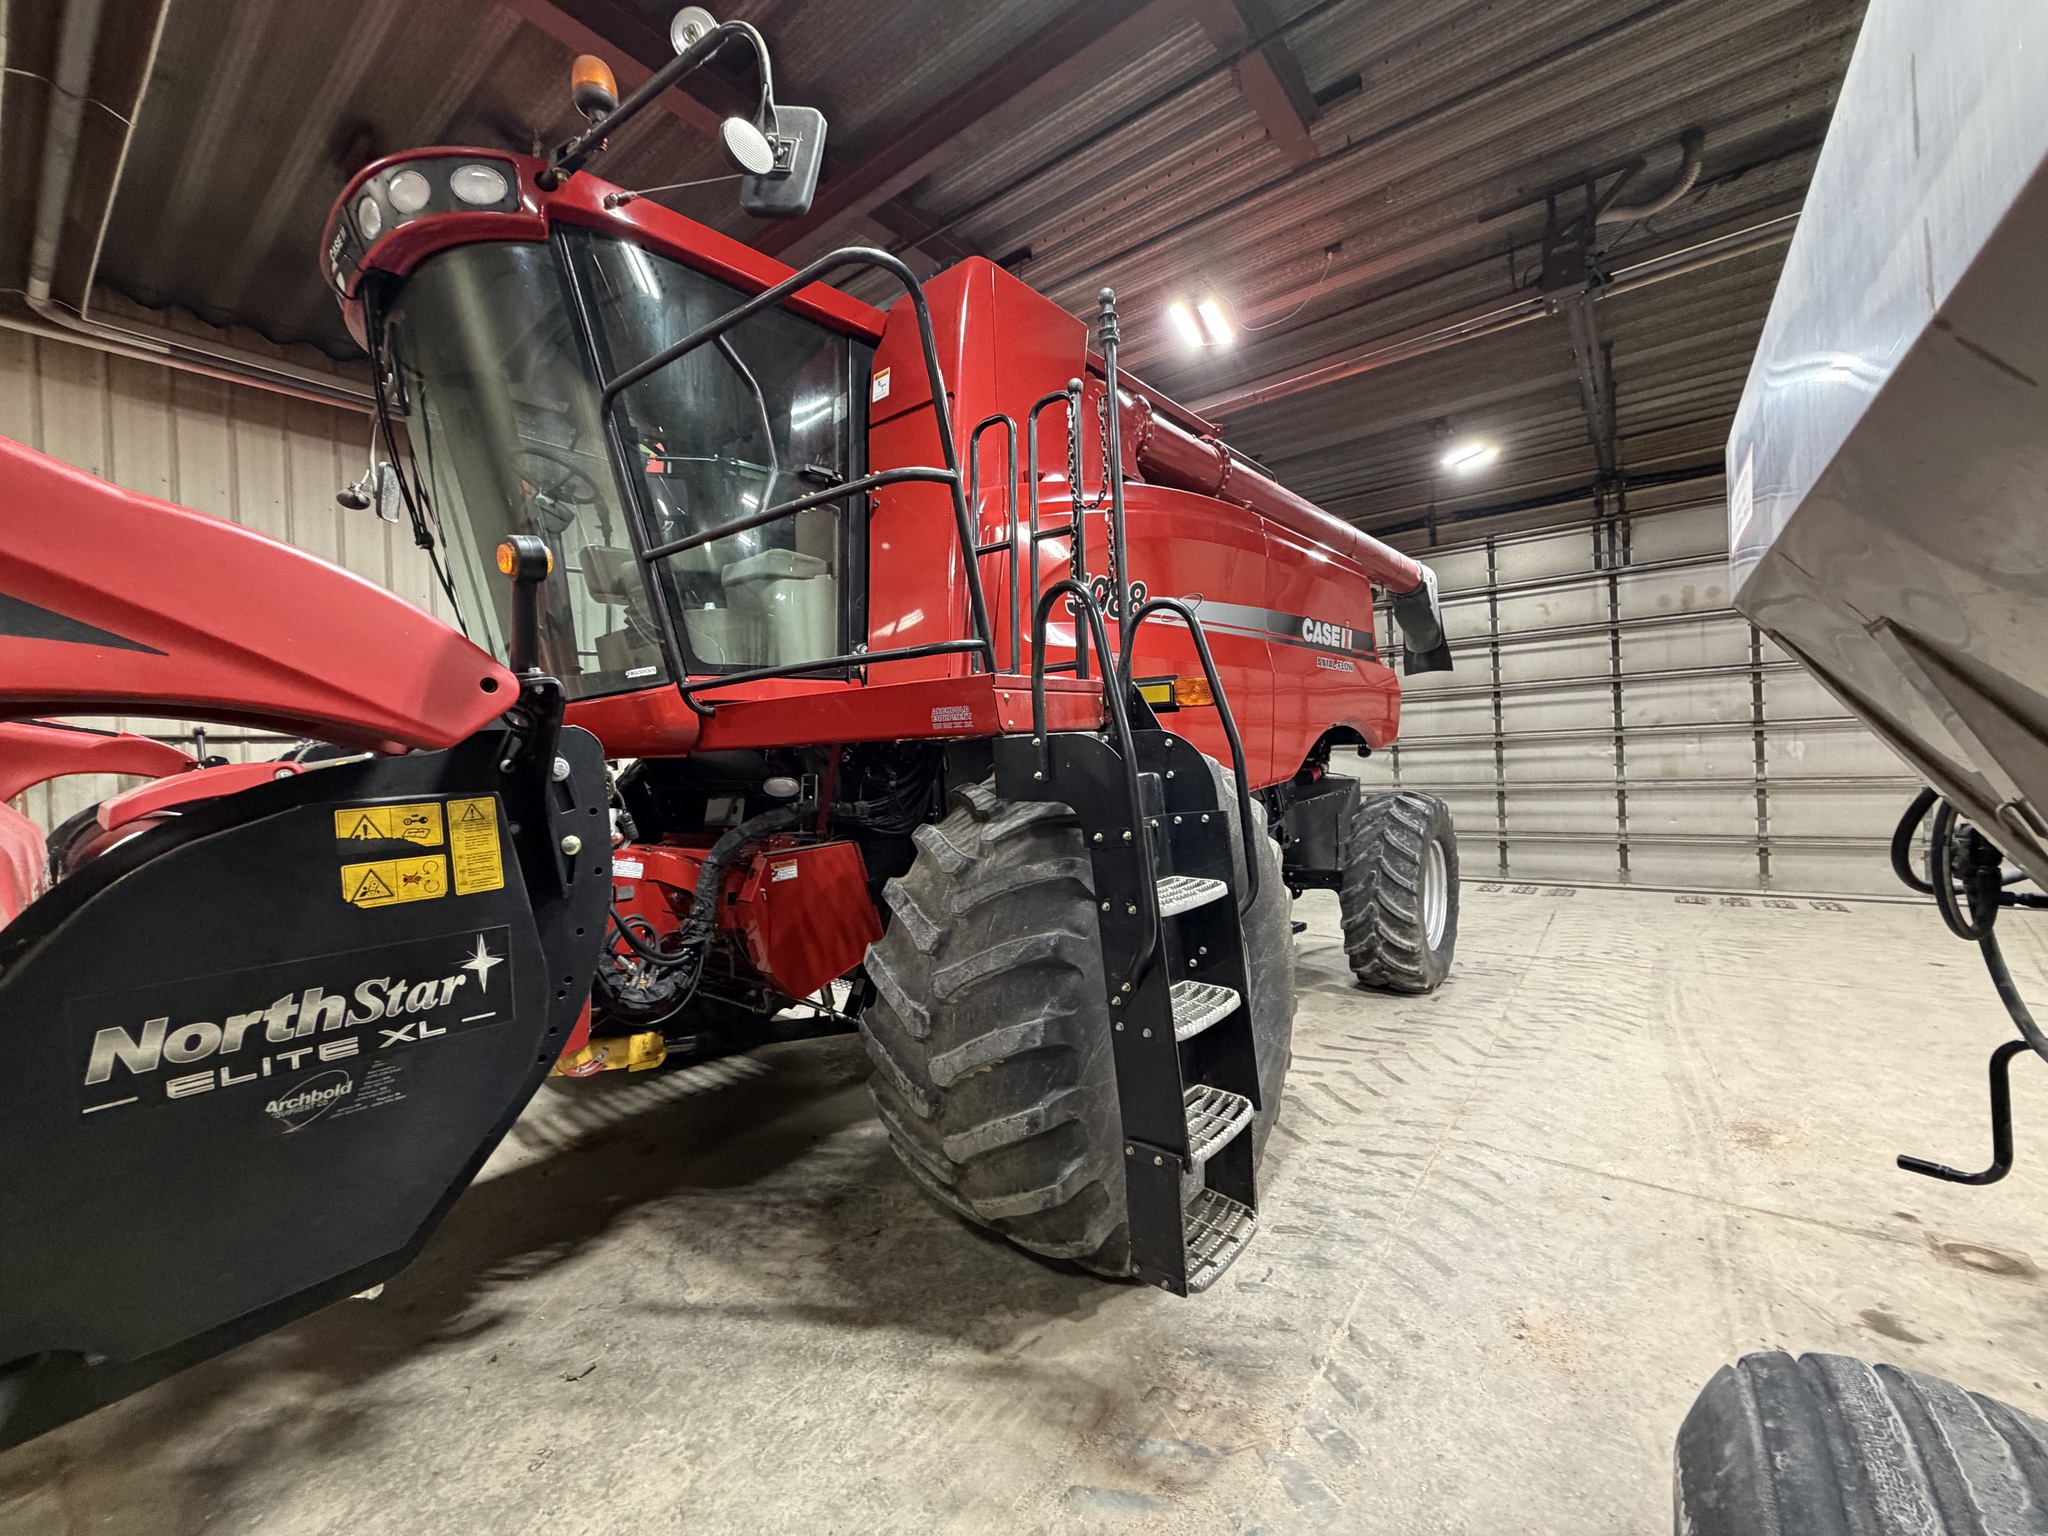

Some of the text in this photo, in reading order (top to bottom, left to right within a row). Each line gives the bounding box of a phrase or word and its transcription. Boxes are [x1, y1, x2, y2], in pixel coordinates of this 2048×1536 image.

[1303, 618, 1340, 647] CASE
[166, 1036, 360, 1099] ELITE
[378, 1020, 447, 1049] XL
[265, 1080, 354, 1113] Archbold
